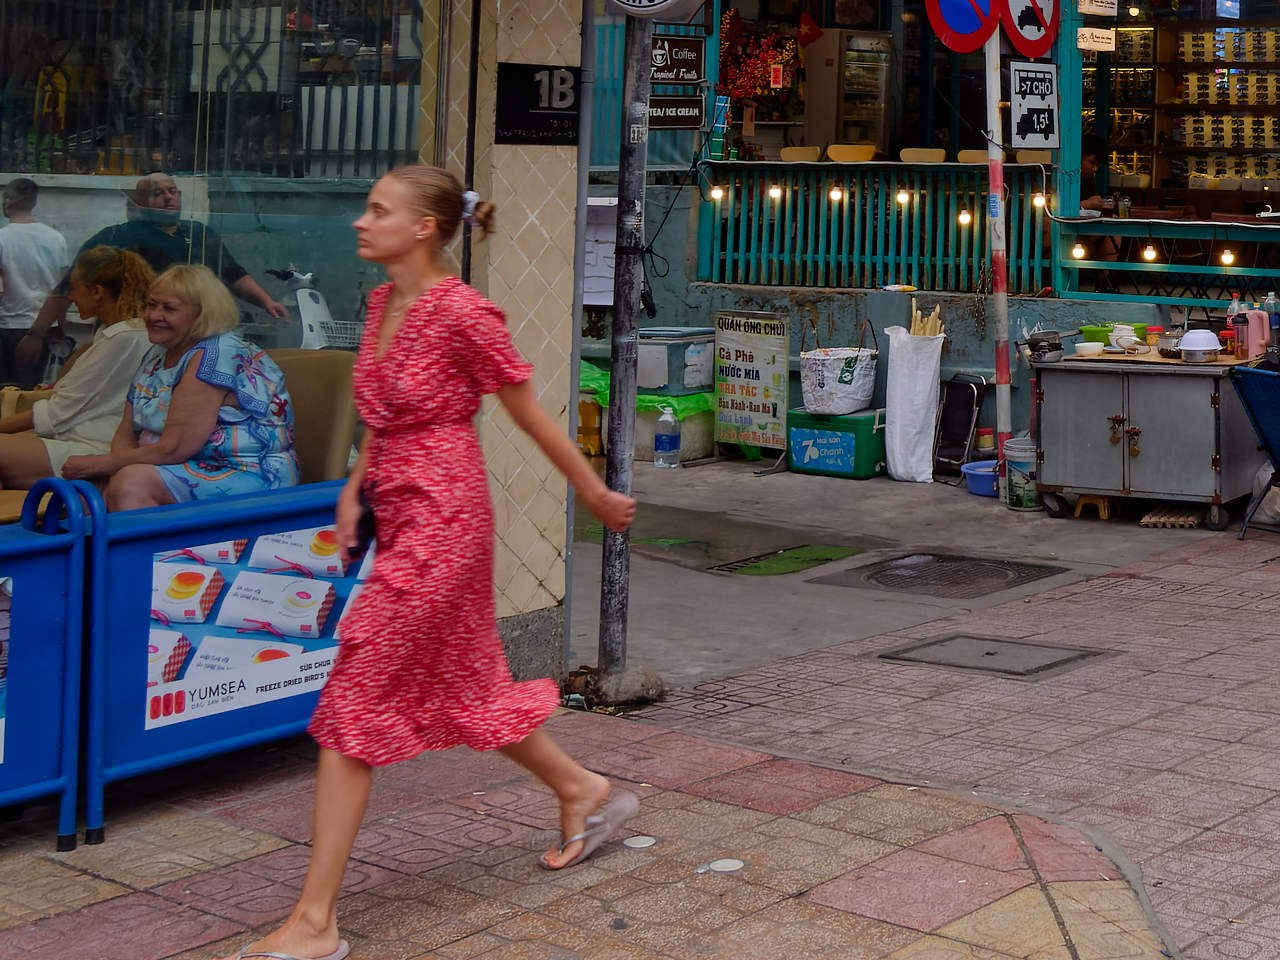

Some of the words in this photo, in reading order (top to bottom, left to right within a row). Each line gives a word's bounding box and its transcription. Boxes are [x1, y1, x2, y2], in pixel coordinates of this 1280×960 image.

[672, 47, 697, 60] Coffee
[533, 69, 576, 109] 1B
[677, 107, 699, 117] CREAM
[188, 679, 247, 701] YUMSEA
[255, 682, 281, 694] FREEZE
[283, 677, 303, 688] DRIED
[304, 673, 325, 684] BIRD'S
